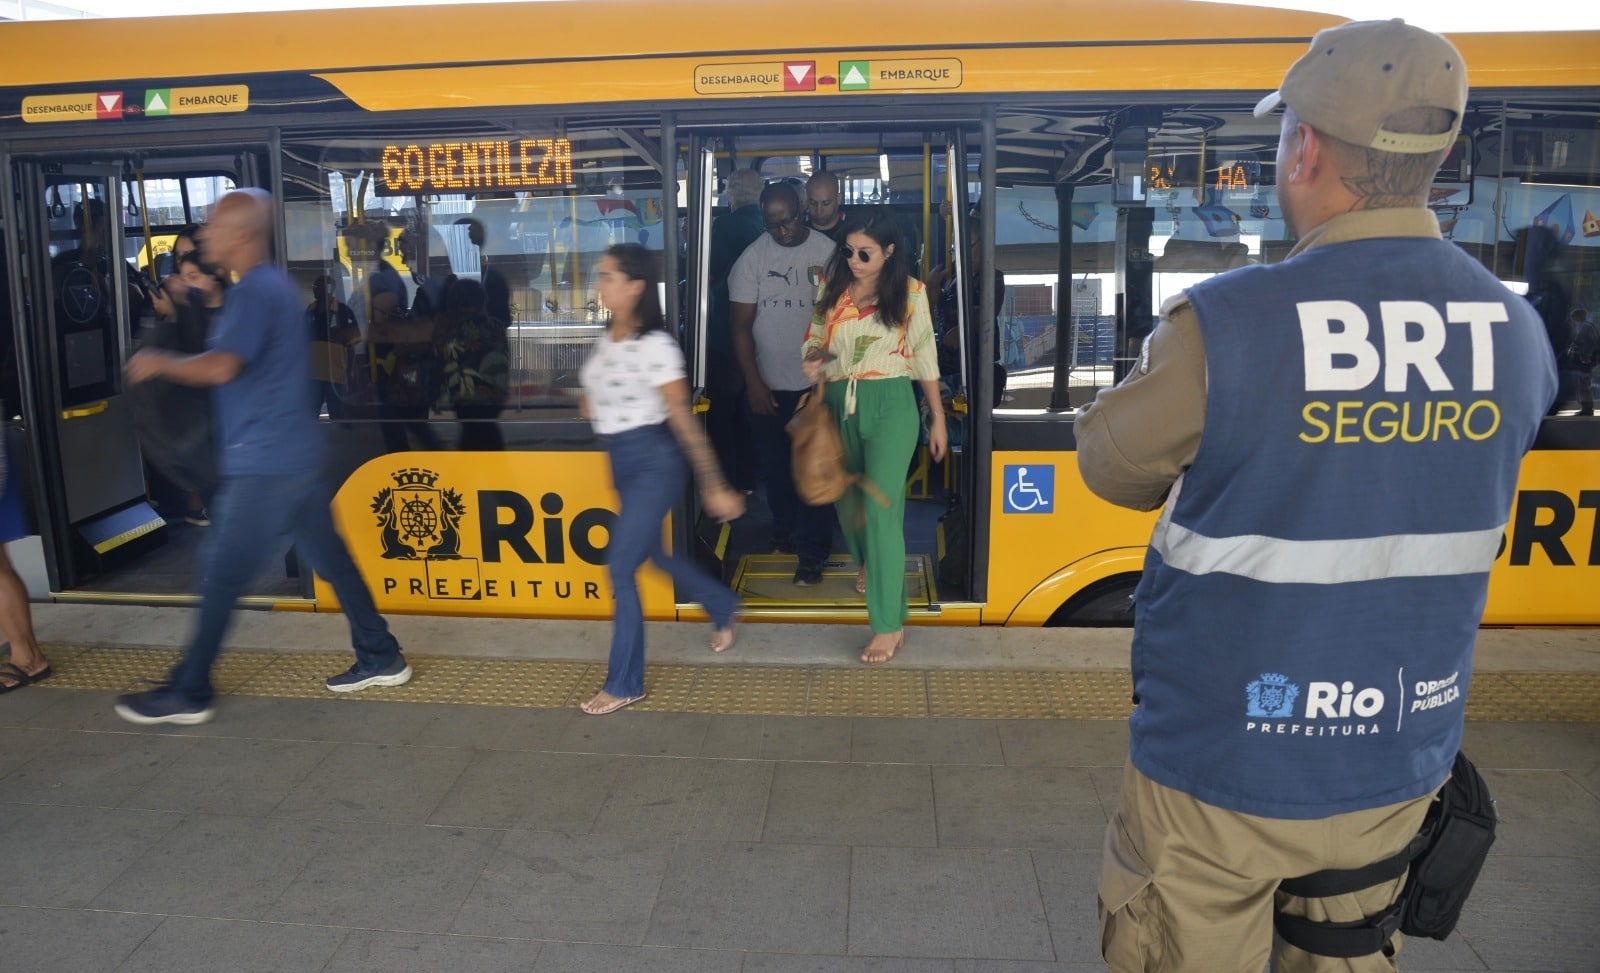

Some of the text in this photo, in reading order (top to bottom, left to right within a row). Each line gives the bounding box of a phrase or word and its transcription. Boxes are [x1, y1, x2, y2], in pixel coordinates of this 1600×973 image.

[700, 73, 780, 85] DESEMBARQUE
[880, 68, 950, 81] EMBARQUE
[26, 102, 94, 115] DESEMBARQUE
[178, 94, 239, 107] EMBARQUE
[382, 138, 573, 190] 60 GENTILEZA
[1296, 300, 1510, 392] BRT
[1299, 399, 1501, 443] SEGURO
[477, 490, 621, 566] Rio
[384, 578, 617, 599] PREFEITUR
[1305, 681, 1385, 719] Rio
[1246, 722, 1380, 736] PREFEITURA
